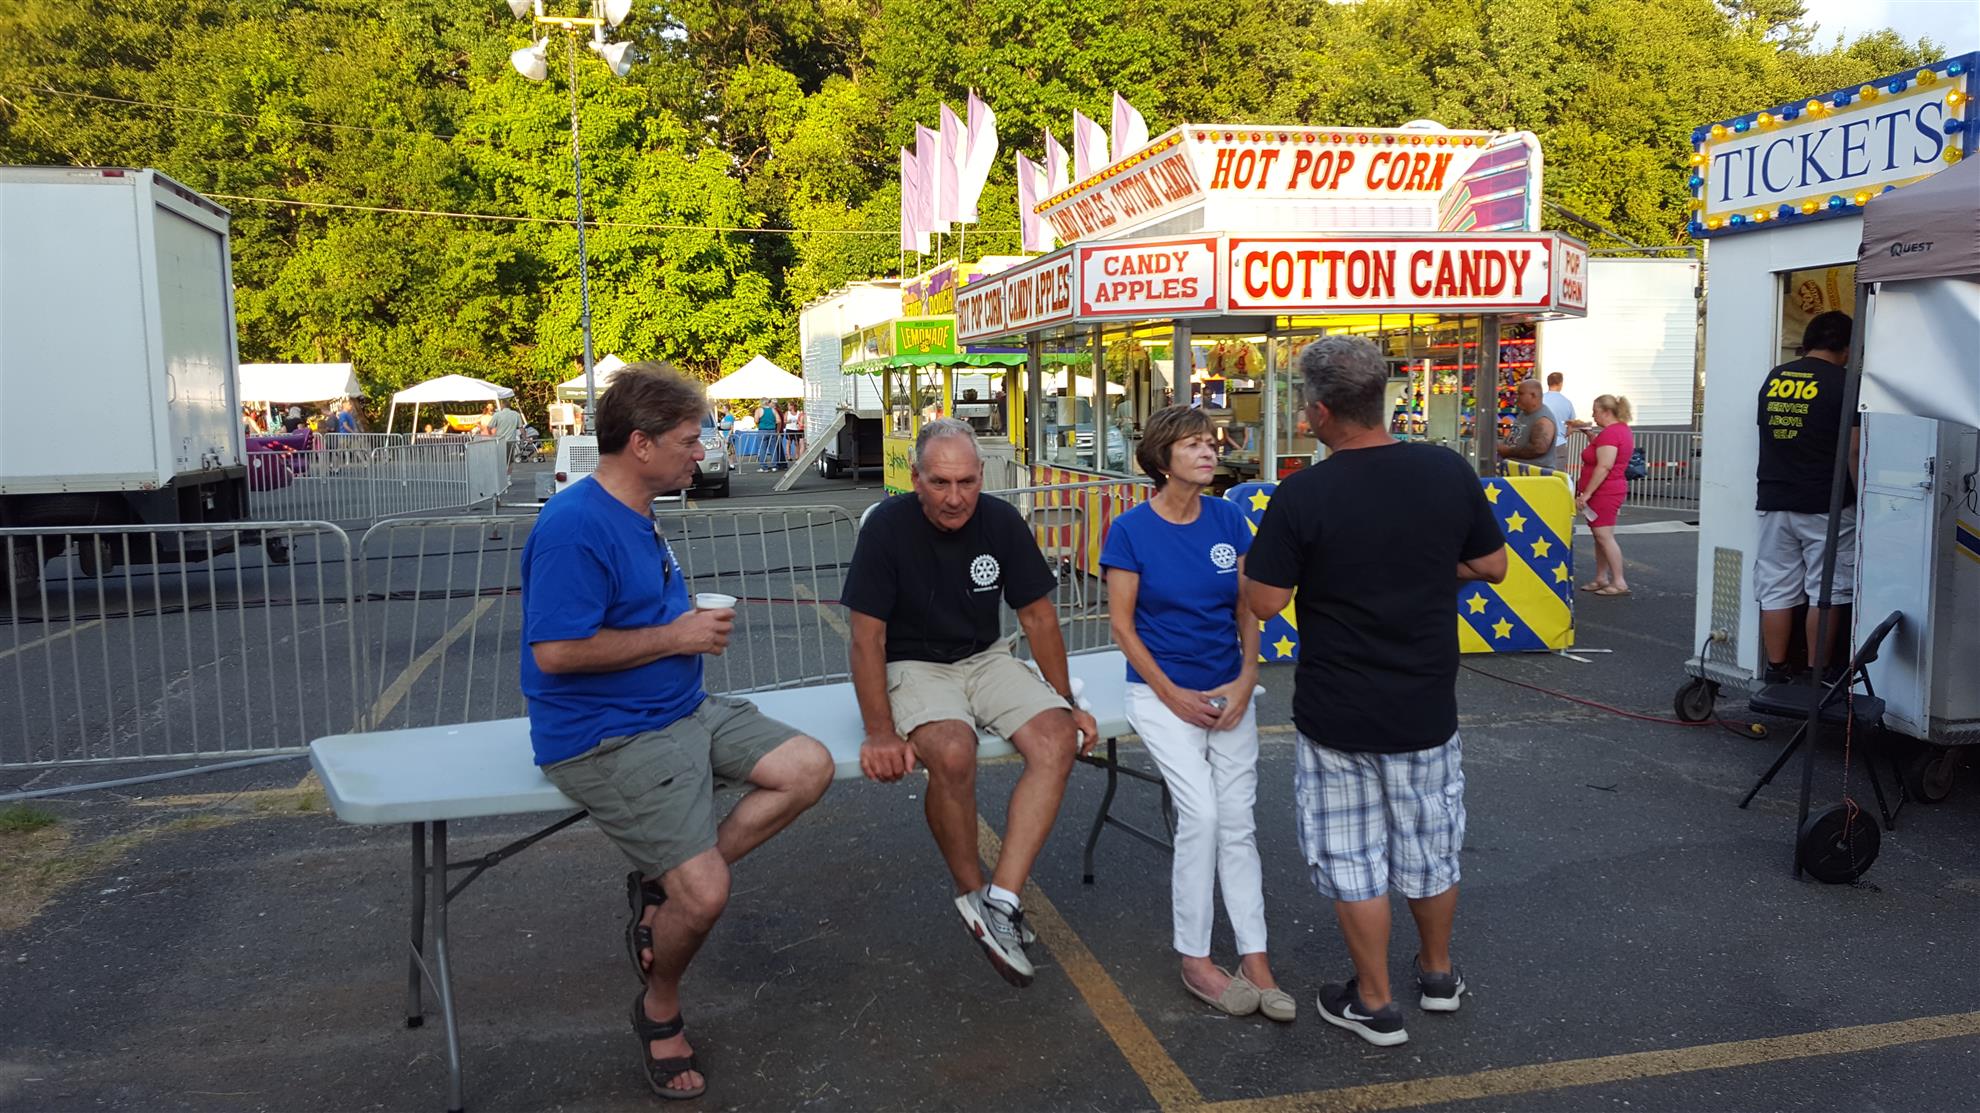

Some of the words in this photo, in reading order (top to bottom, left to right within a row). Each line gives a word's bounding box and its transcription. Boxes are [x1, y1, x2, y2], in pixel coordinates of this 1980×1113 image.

[1714, 100, 1944, 203] TICKETS
[1211, 148, 1280, 190] HOT
[1288, 150, 1354, 191] POP
[1366, 152, 1454, 192] CORN
[1048, 206, 1085, 243] CANDY
[1074, 192, 1117, 234] APPLES
[1110, 173, 1163, 219] COTTON
[1149, 153, 1201, 203] CANDY
[1565, 250, 1580, 275] POP
[1890, 242, 1934, 257] QUEST
[1104, 250, 1189, 276] CANDY
[1244, 250, 1397, 299] COTTON
[1409, 249, 1531, 298] CANDY
[928, 287, 953, 315] DOUGH
[1008, 276, 1034, 322] CANDY
[1035, 264, 1071, 316] APPLES
[1095, 277, 1198, 303] APPLES
[1562, 277, 1583, 304] CORN
[958, 297, 971, 334] HOT
[972, 293, 983, 330] POP
[984, 288, 1003, 327] CORN
[900, 325, 950, 349] LEMONADE
[1766, 378, 1819, 400] 2016
[1767, 401, 1809, 414] SERVICE
[1773, 428, 1798, 440] SELF
